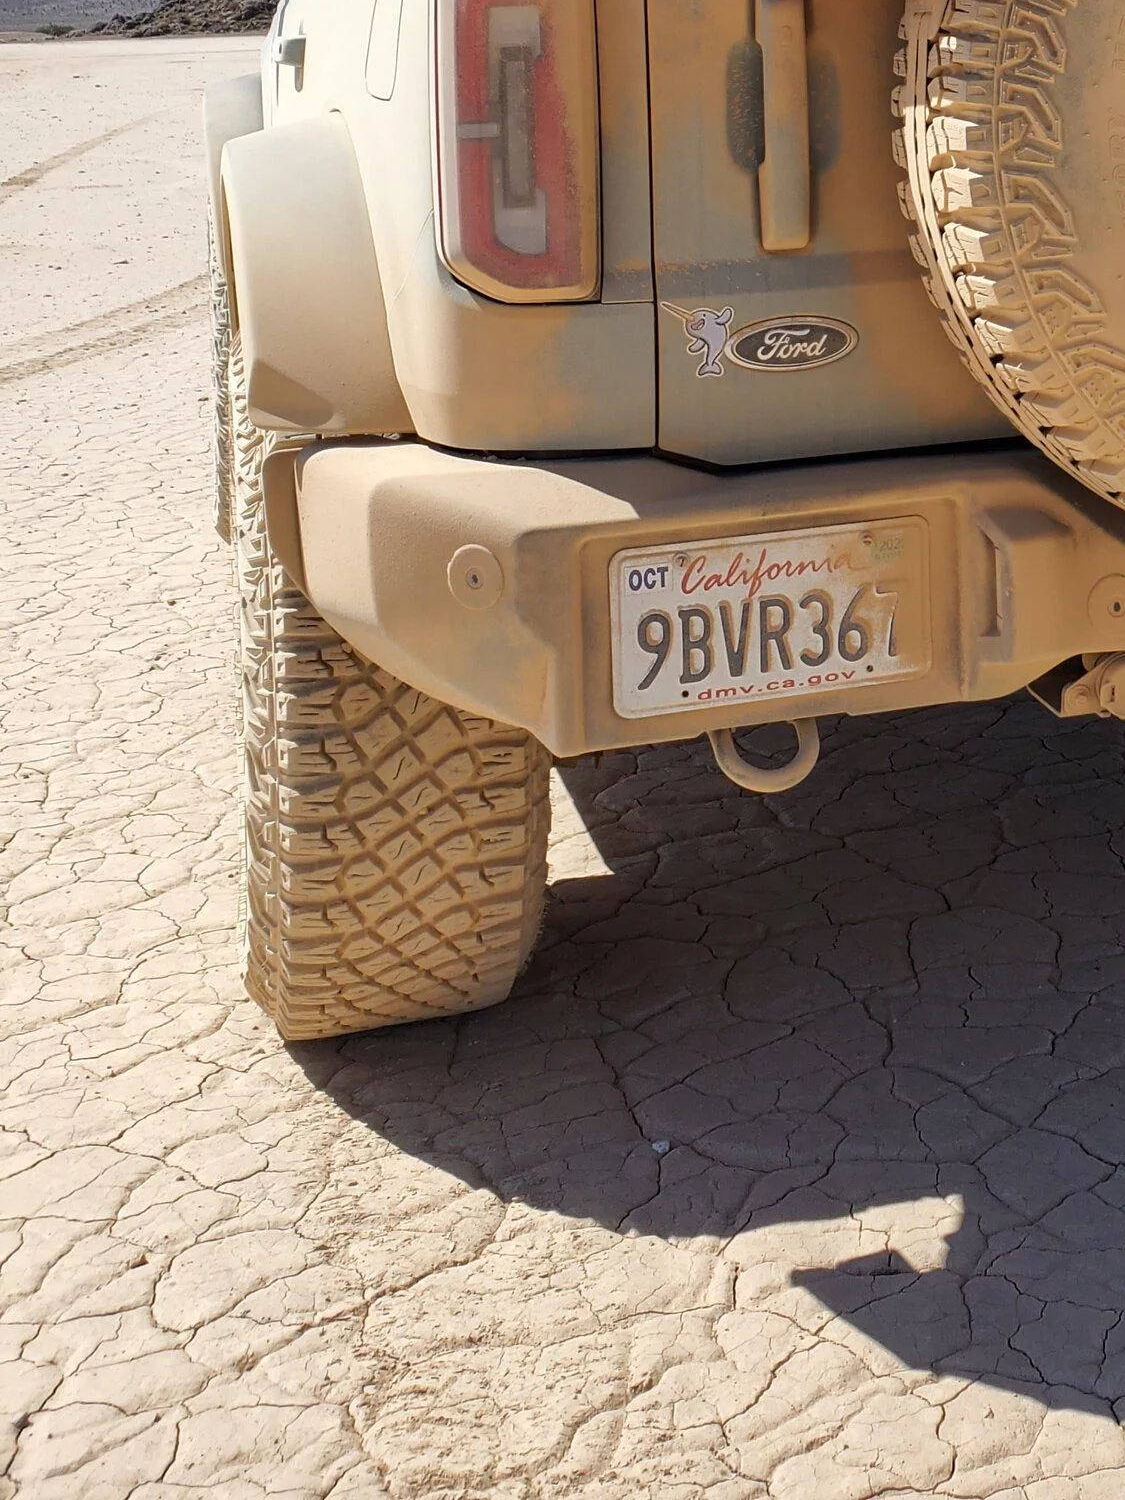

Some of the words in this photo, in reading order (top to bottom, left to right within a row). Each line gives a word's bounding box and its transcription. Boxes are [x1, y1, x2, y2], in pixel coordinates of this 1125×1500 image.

[756, 328, 828, 361] Ford
[629, 566, 670, 592] OCT
[680, 548, 852, 598] California
[636, 579, 904, 691] 9BVR367
[696, 669, 857, 701] dmv.ca.gov
